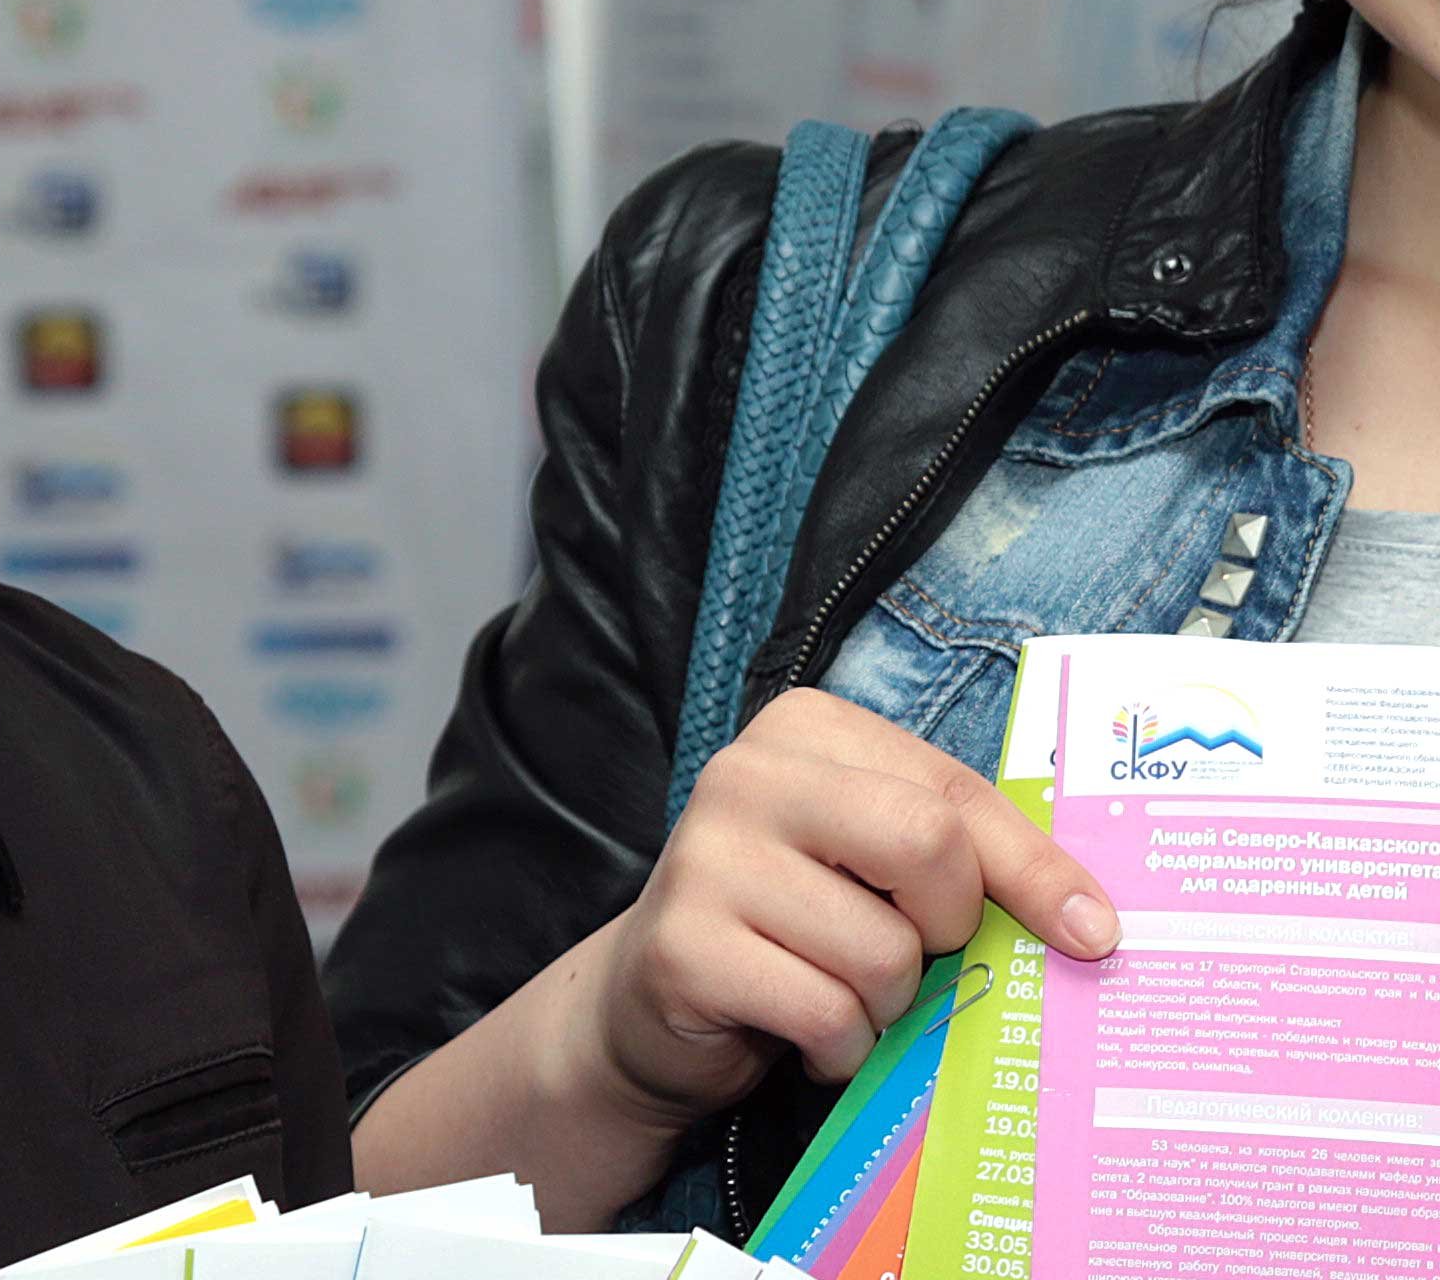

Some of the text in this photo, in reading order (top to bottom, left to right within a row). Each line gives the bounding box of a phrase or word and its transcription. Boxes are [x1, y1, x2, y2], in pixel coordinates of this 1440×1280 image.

[1109, 756, 1188, 780] СКФУ
[1148, 826, 1440, 856] Лицей Северо-Кавказского
[1144, 850, 1296, 872] федерального
[1179, 876, 1407, 900] для одаренных детей
[1151, 1138, 1168, 1151] 53
[1173, 1142, 1232, 1155] человека,
[1237, 1145, 1252, 1155] из
[1257, 1147, 1306, 1159] которых
[1310, 1147, 1328, 1160] 26
[1333, 1151, 1381, 1163] человек
[1386, 1154, 1425, 1167] имеют
